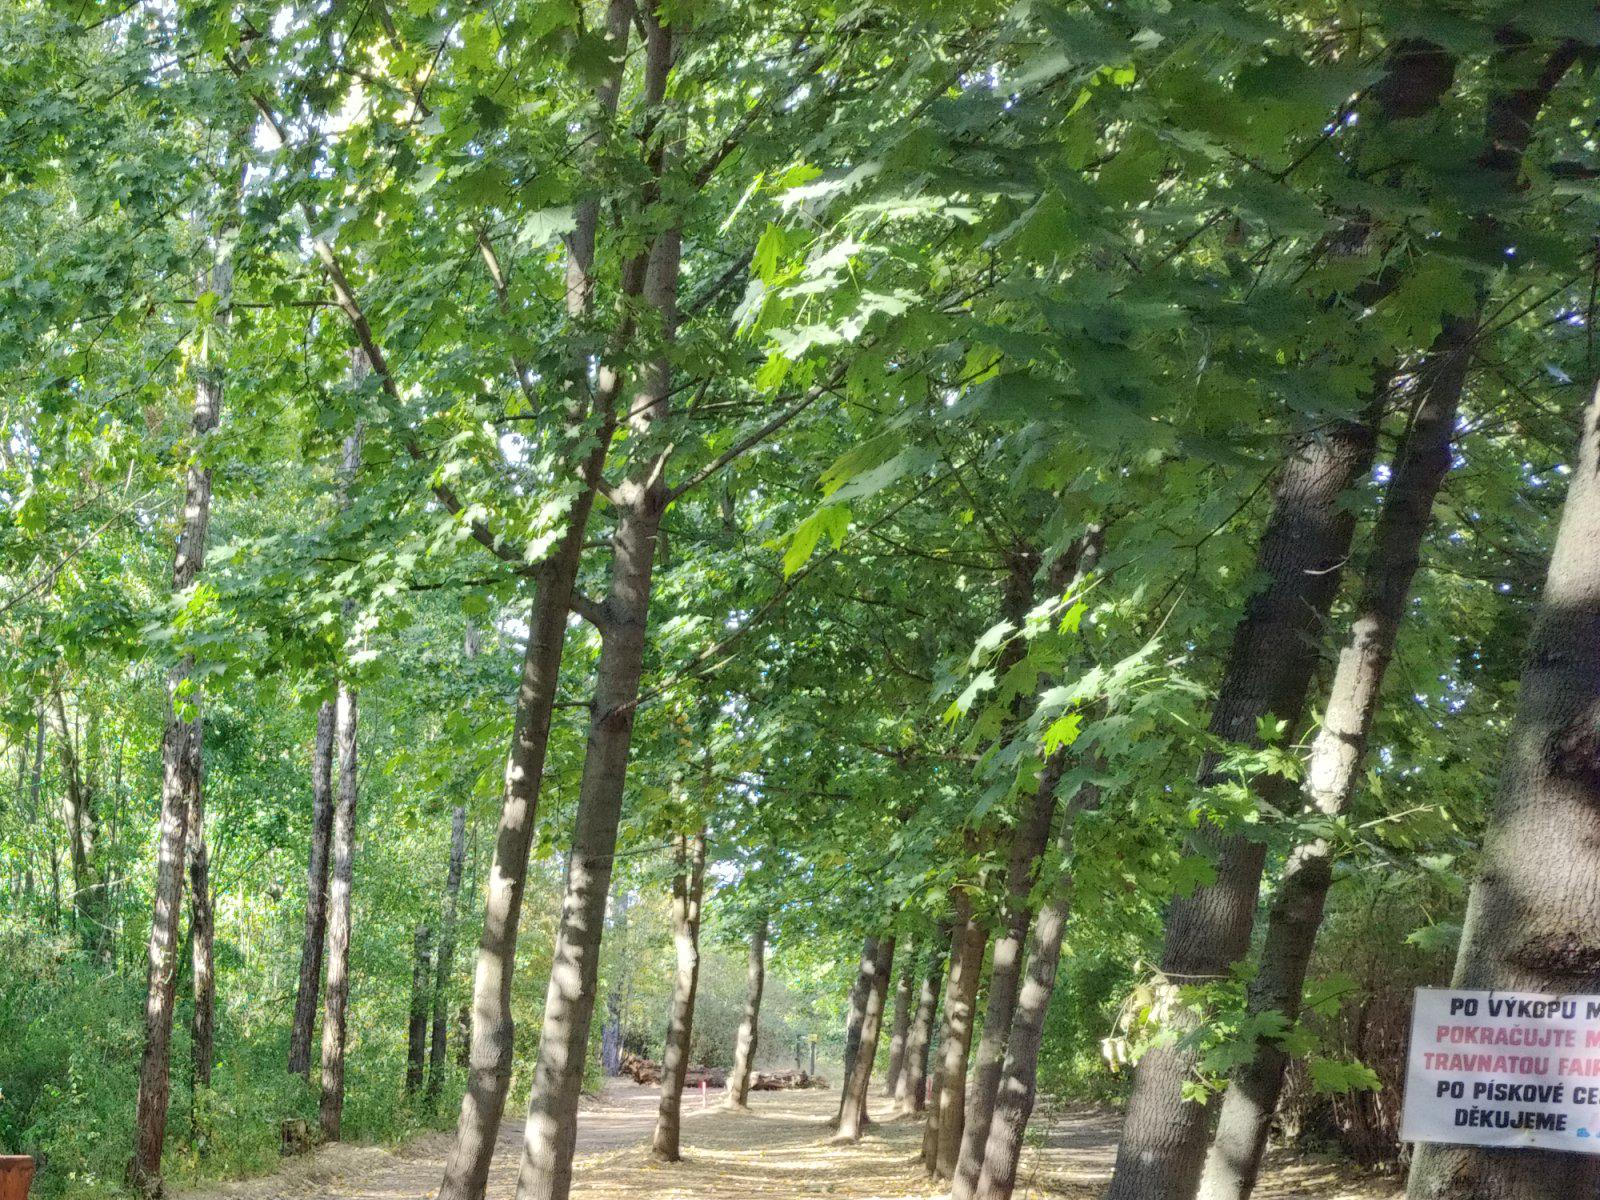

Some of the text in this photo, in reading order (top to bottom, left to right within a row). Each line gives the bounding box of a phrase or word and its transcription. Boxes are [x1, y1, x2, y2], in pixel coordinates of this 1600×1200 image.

[1450, 997, 1479, 1017] PO
[1488, 996, 1576, 1020] VÝKOPU
[1436, 1024, 1576, 1048] POKRAČUJTE
[1424, 1052, 1549, 1076] TRAVNATOU
[1436, 1079, 1600, 1105] PO PÍSKOVÉ CE
[1455, 1106, 1568, 1132] DĚKUJEME
